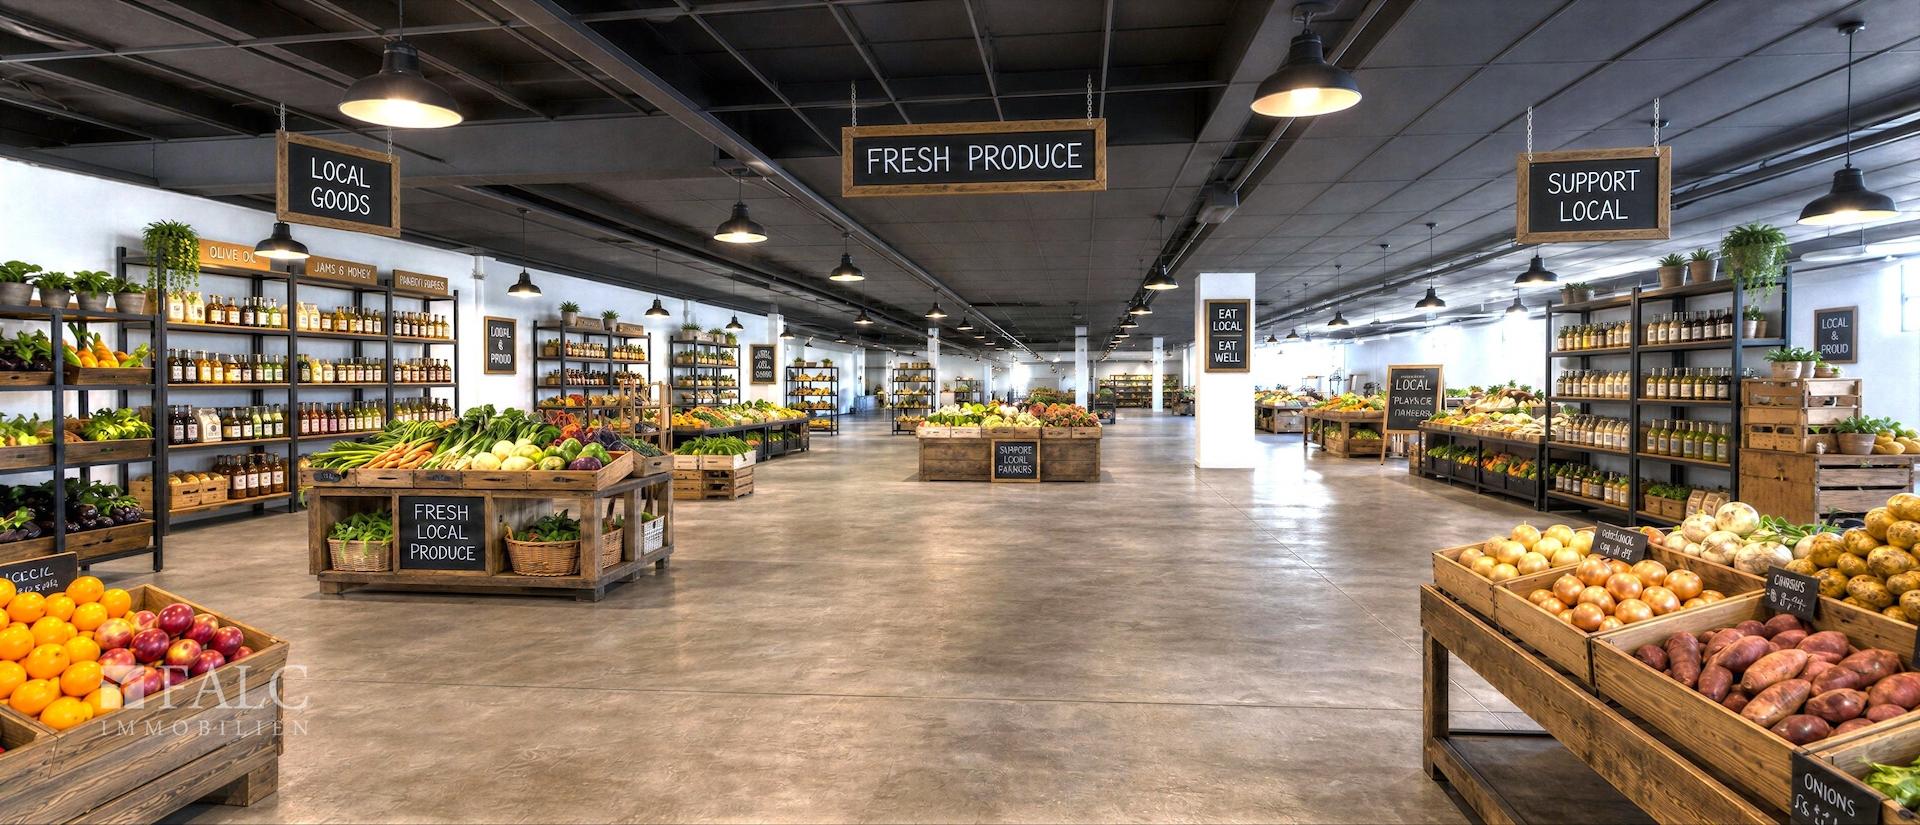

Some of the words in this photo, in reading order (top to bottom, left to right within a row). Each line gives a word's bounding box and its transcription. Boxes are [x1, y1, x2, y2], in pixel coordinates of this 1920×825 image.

[867, 146, 950, 174] FRESH
[968, 142, 1083, 171] PRODUCE
[311, 157, 371, 188] LOCAL
[1547, 169, 1641, 195] SUPPORT
[311, 186, 371, 215] GOODS
[1560, 198, 1629, 222] LOCAL
[209, 246, 239, 262] OLIVE
[1218, 308, 1238, 320] EAT
[1213, 320, 1243, 331] LOCAL
[1821, 317, 1849, 329] LOCAL
[1831, 330, 1839, 341] &
[1218, 340, 1238, 351] EAT
[1821, 343, 1849, 355] PROUD
[1214, 352, 1241, 363] WELL
[1395, 379, 1432, 391] LOCAL
[414, 503, 469, 521] FRESH
[417, 524, 469, 540] LOCAL
[410, 543, 476, 561] PRODUCE
[1804, 773, 1855, 817] ONIONS
